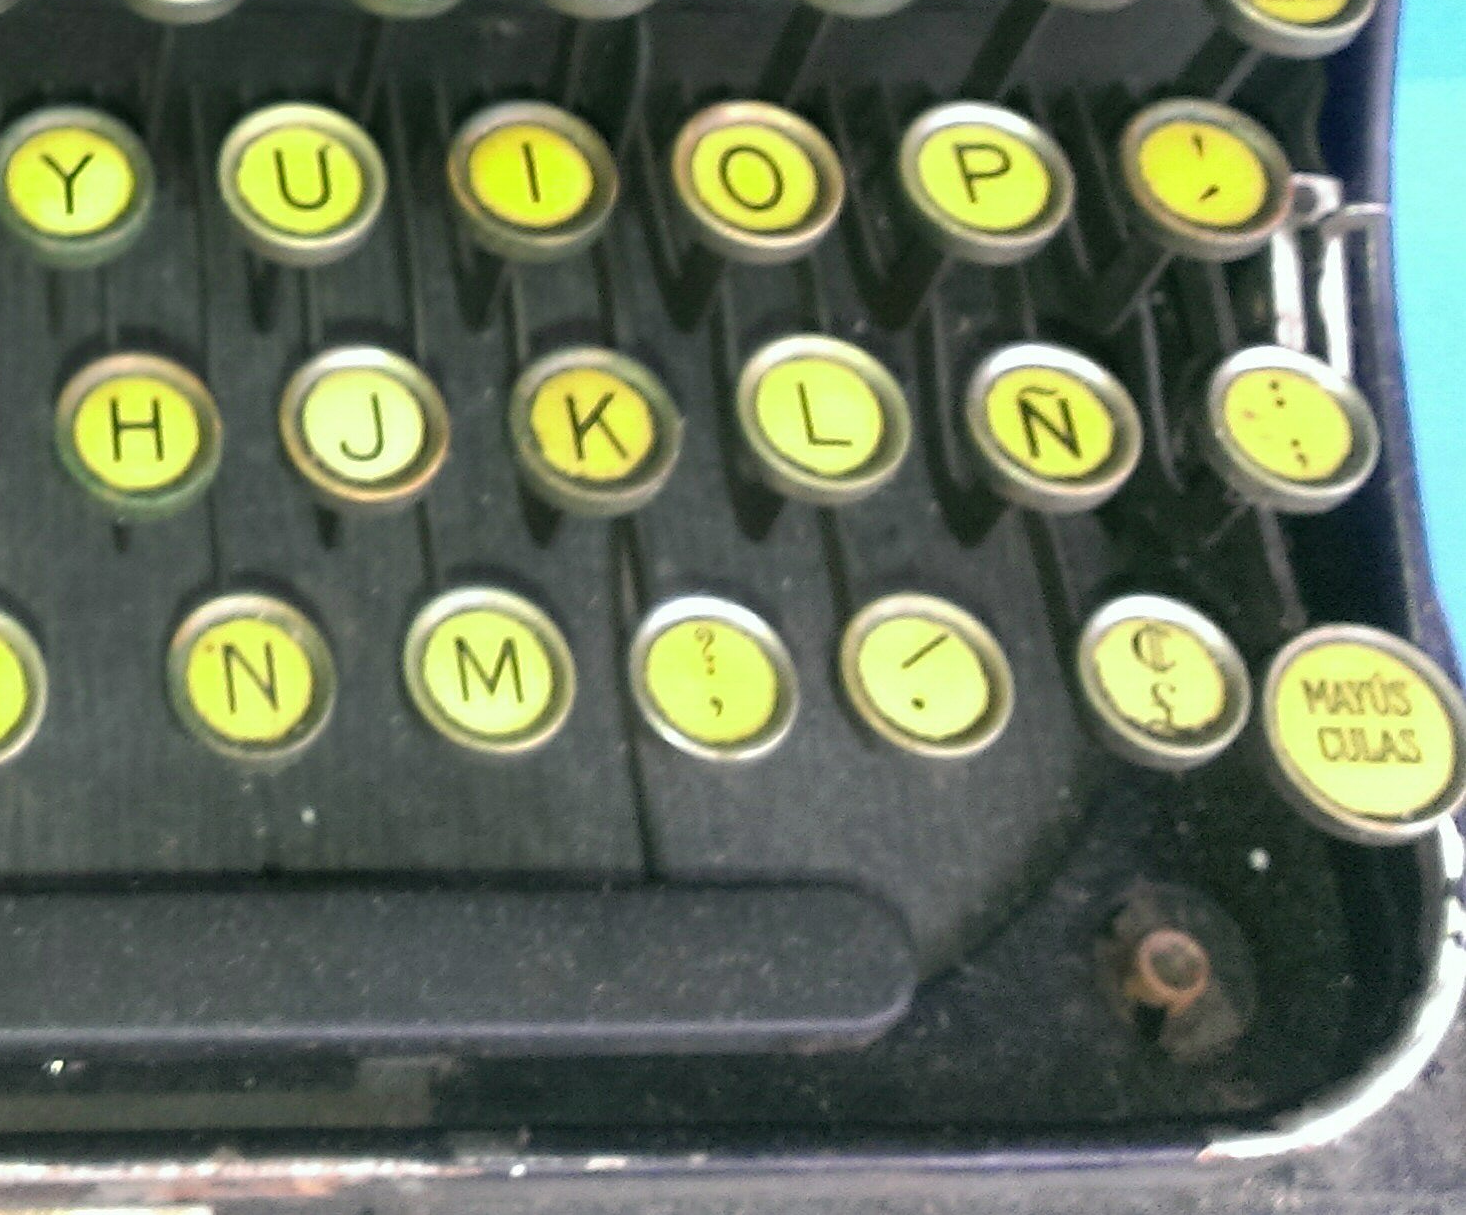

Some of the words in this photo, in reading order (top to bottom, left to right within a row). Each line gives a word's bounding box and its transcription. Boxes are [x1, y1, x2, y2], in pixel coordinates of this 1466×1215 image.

[40, 152, 95, 215] Y
[274, 141, 334, 210] U
[719, 144, 784, 211] O
[954, 142, 1012, 204] P
[108, 396, 165, 462] H
[339, 391, 384, 462] J
[564, 391, 630, 463] K
[797, 381, 854, 448] L
[1015, 385, 1083, 460] Ñ
[221, 639, 280, 715] N
[453, 635, 526, 704] M
[1317, 727, 1422, 765] CULAS
